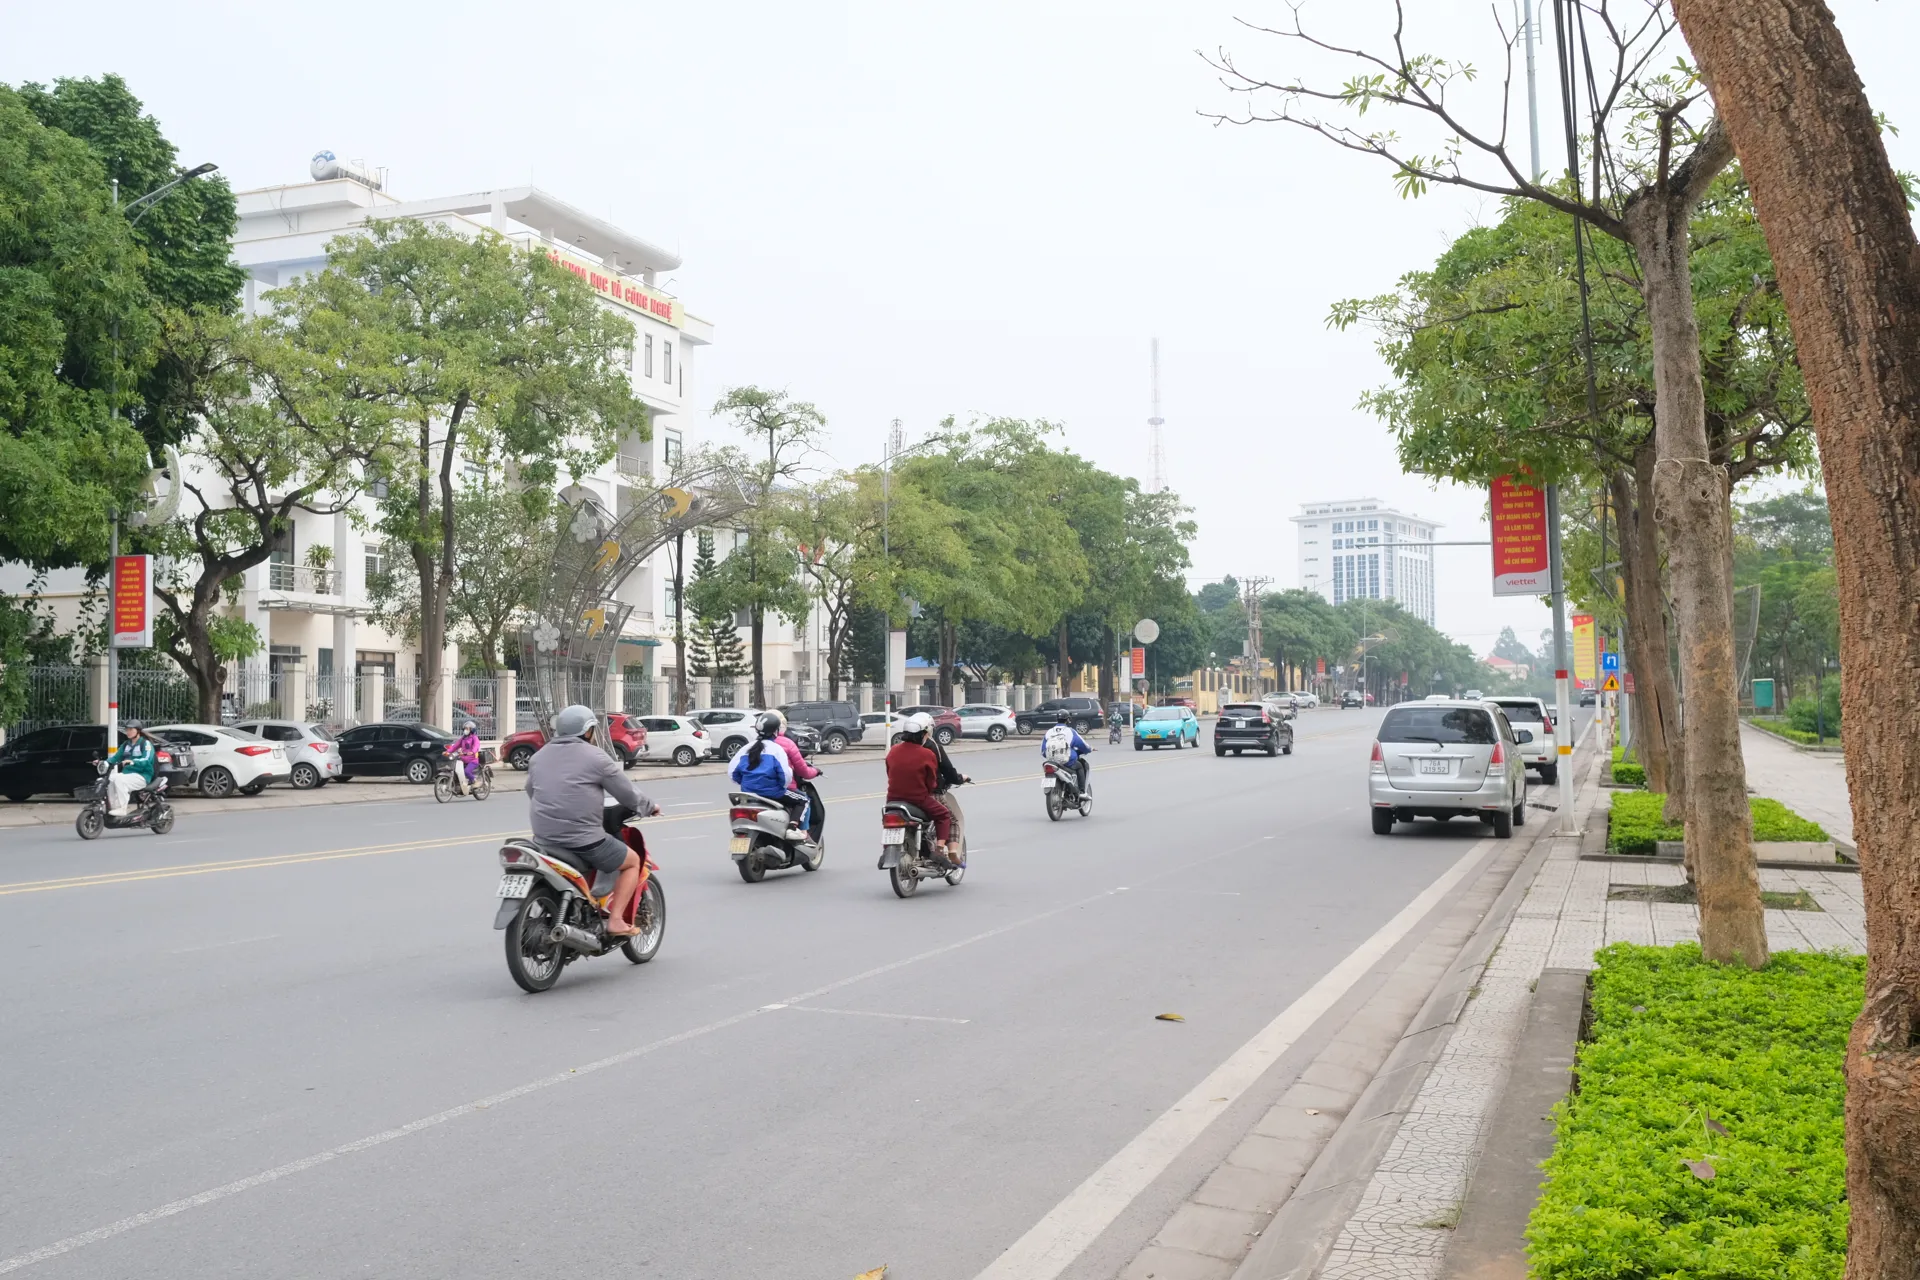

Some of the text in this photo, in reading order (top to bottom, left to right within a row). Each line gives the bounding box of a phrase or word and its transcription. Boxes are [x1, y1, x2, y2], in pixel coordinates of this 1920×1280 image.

[590, 271, 608, 293] HỌC
[611, 279, 622, 299] VÀ
[625, 286, 648, 310] CÔNG
[650, 298, 672, 323] NGHỆ
[1505, 578, 1537, 586] viettel
